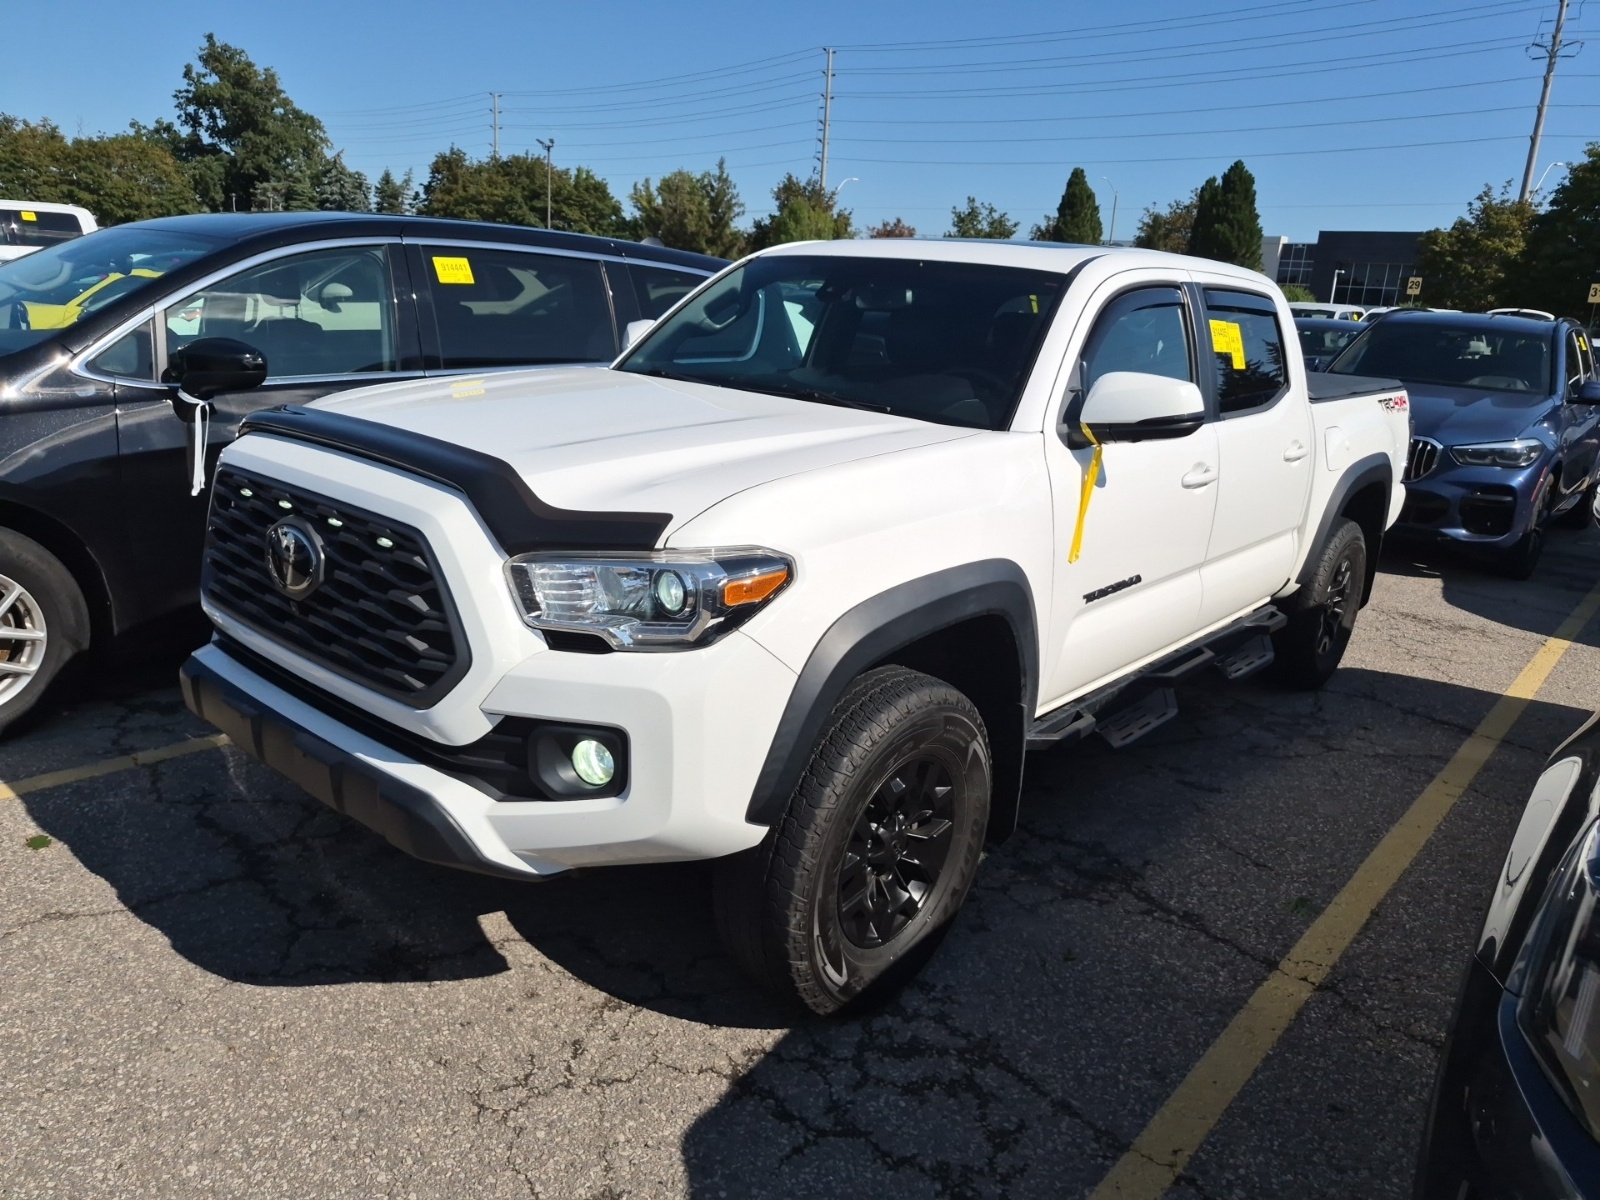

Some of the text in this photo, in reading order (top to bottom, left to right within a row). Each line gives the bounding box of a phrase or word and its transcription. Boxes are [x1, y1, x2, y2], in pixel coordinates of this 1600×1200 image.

[440, 263, 468, 272] 914441
[1408, 280, 1421, 290] 29
[1378, 397, 1395, 413] TRD
[1082, 574, 1142, 604] TACOMA
